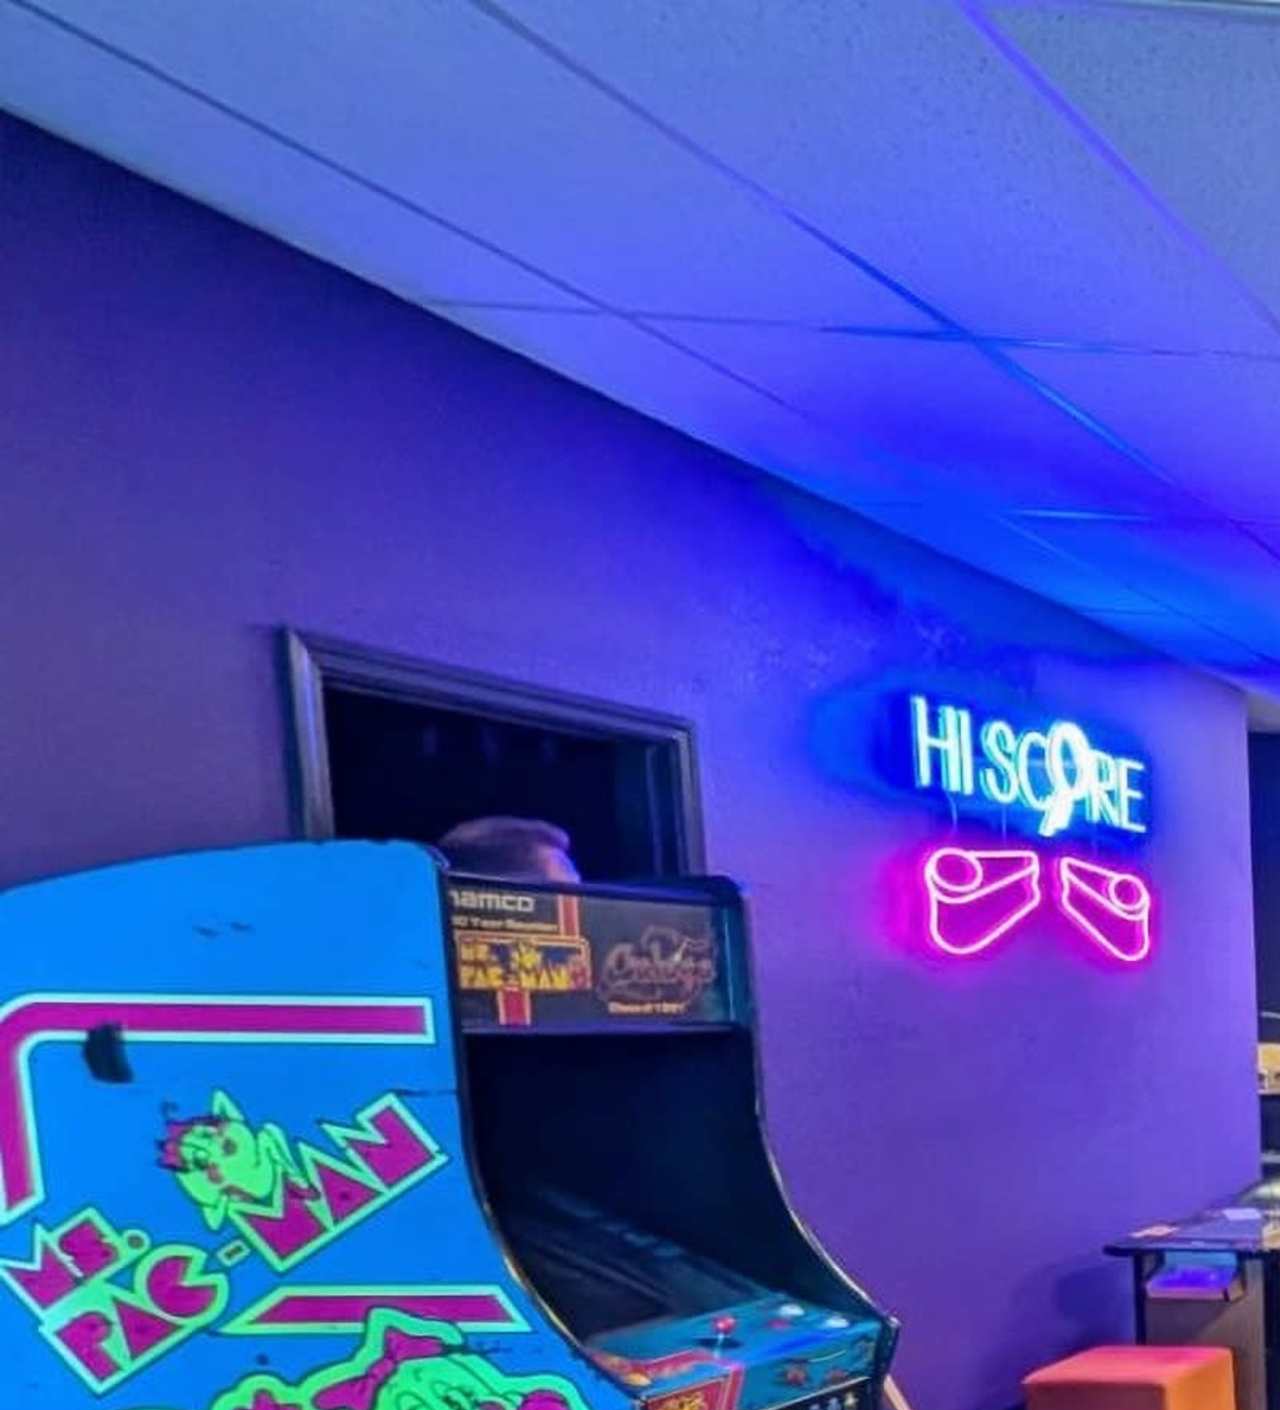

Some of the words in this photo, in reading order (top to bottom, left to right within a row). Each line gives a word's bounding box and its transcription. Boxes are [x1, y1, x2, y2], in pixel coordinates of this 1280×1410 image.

[911, 695, 974, 796] HI
[979, 719, 1147, 837] SCORE
[38, 1093, 448, 1393] PAC-MAN
